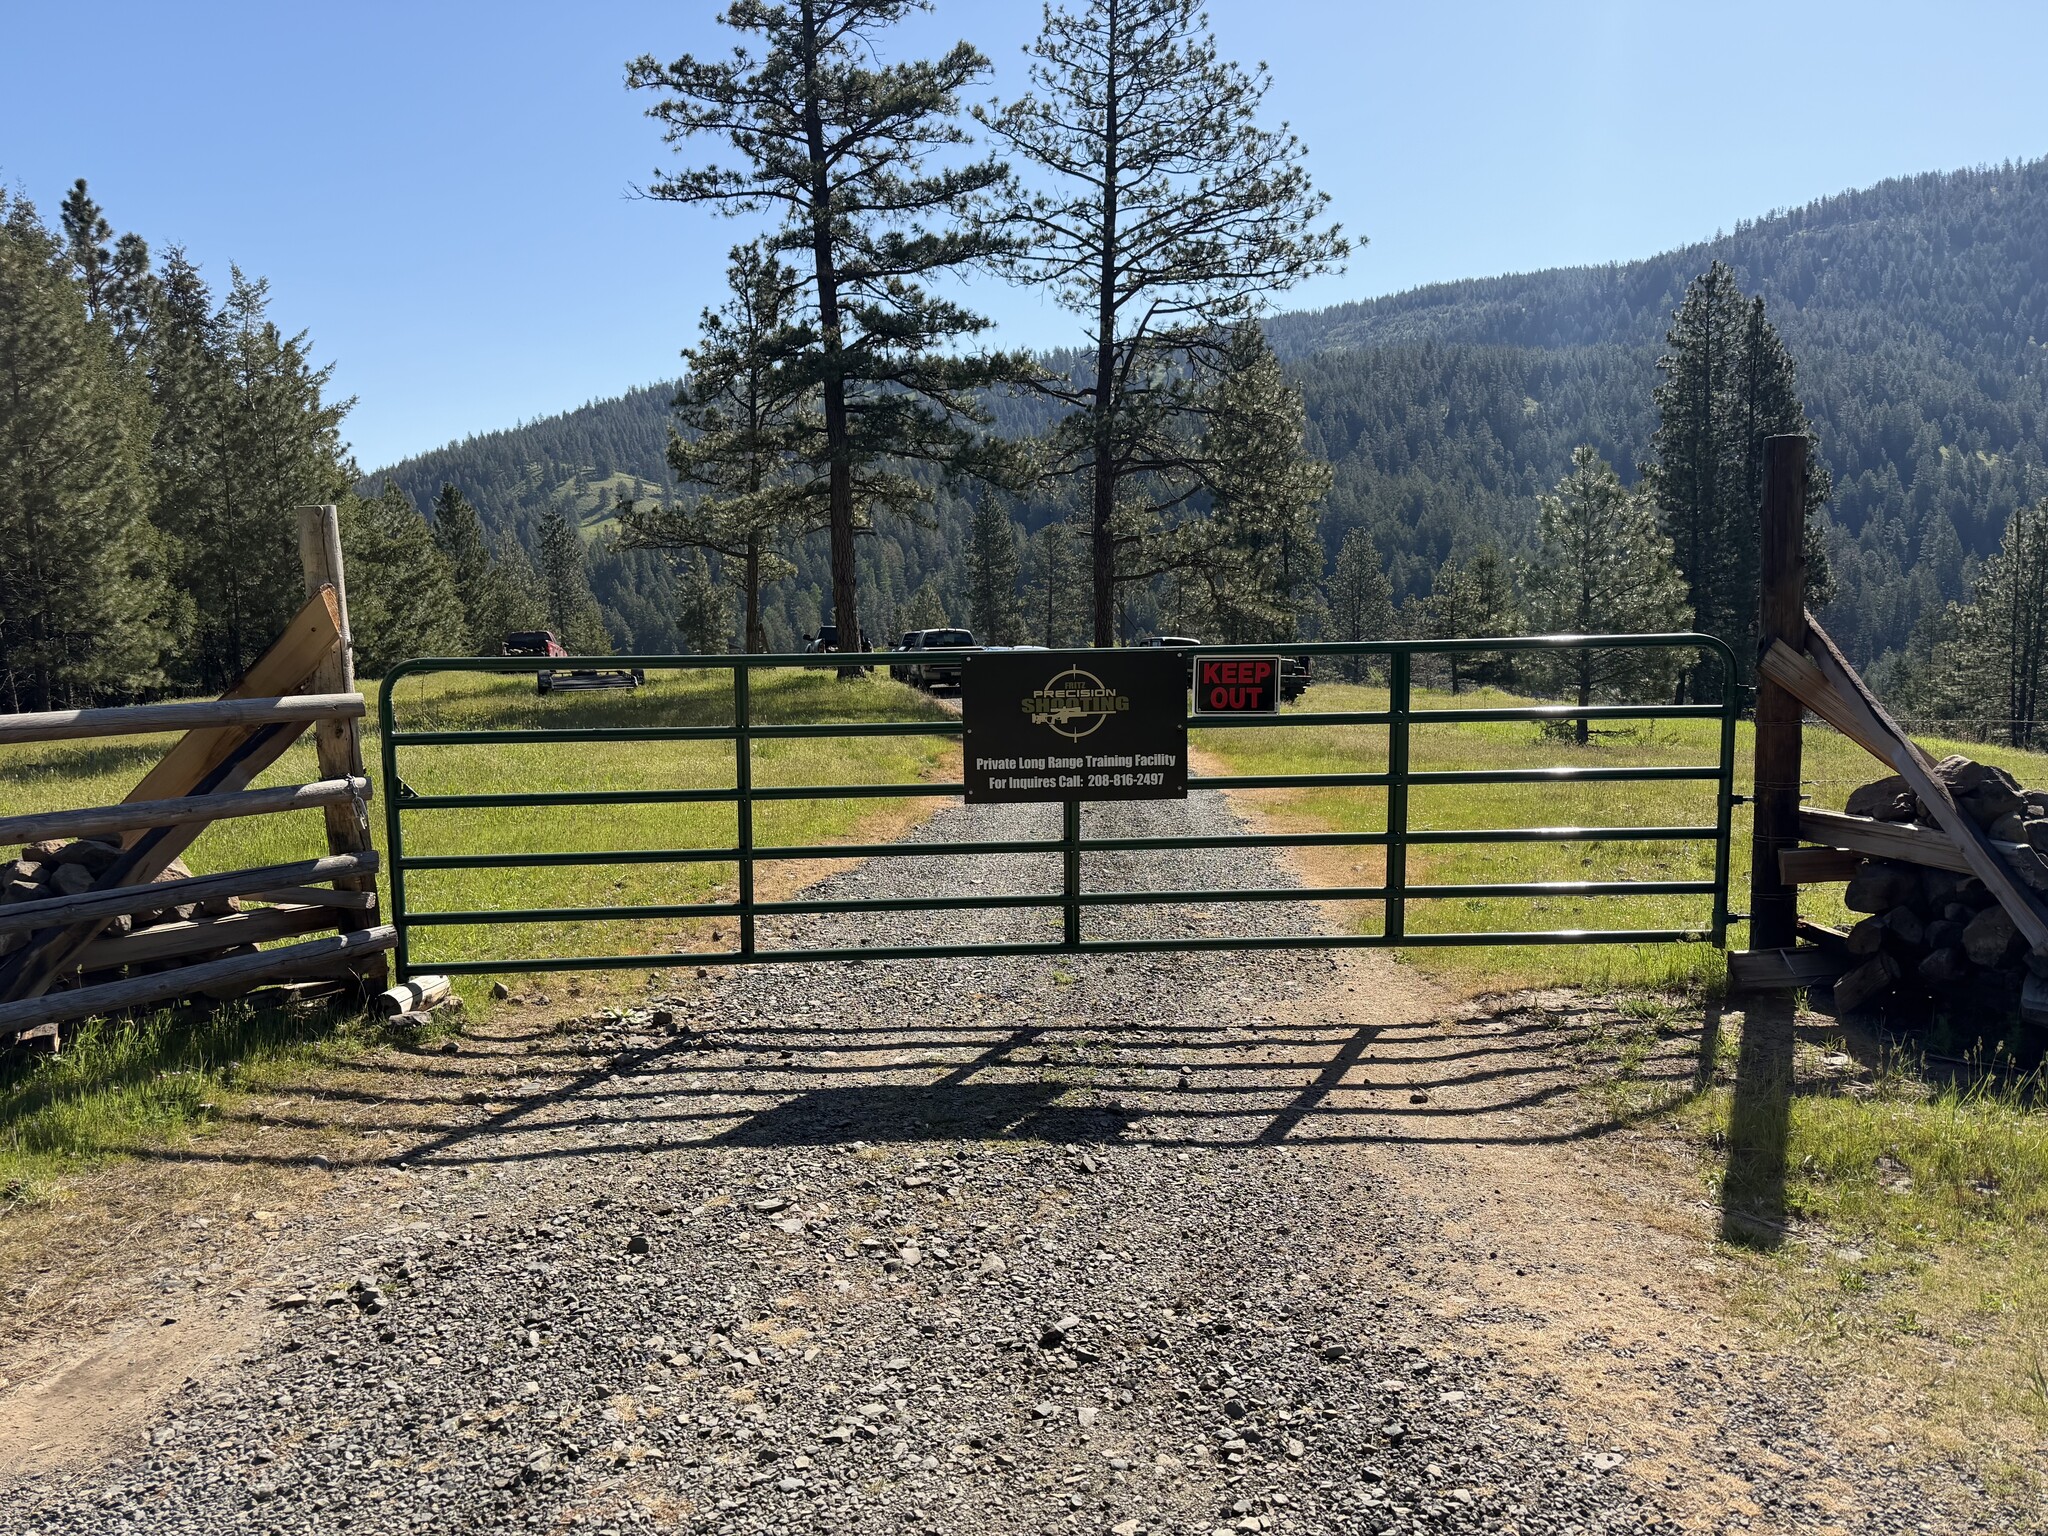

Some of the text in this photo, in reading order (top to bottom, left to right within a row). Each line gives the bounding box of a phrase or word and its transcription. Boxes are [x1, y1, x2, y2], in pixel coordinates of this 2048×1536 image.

[1203, 662, 1271, 684] KEEP
[1033, 689, 1116, 698] PRECISION
[1065, 682, 1086, 690] FRITZ
[1021, 697, 1129, 713] SHOOTING
[1210, 687, 1263, 709] OUT
[976, 753, 1176, 770] Private Long Range Training Facility
[989, 773, 1164, 789] For Inquires Call: 208-816-2497
